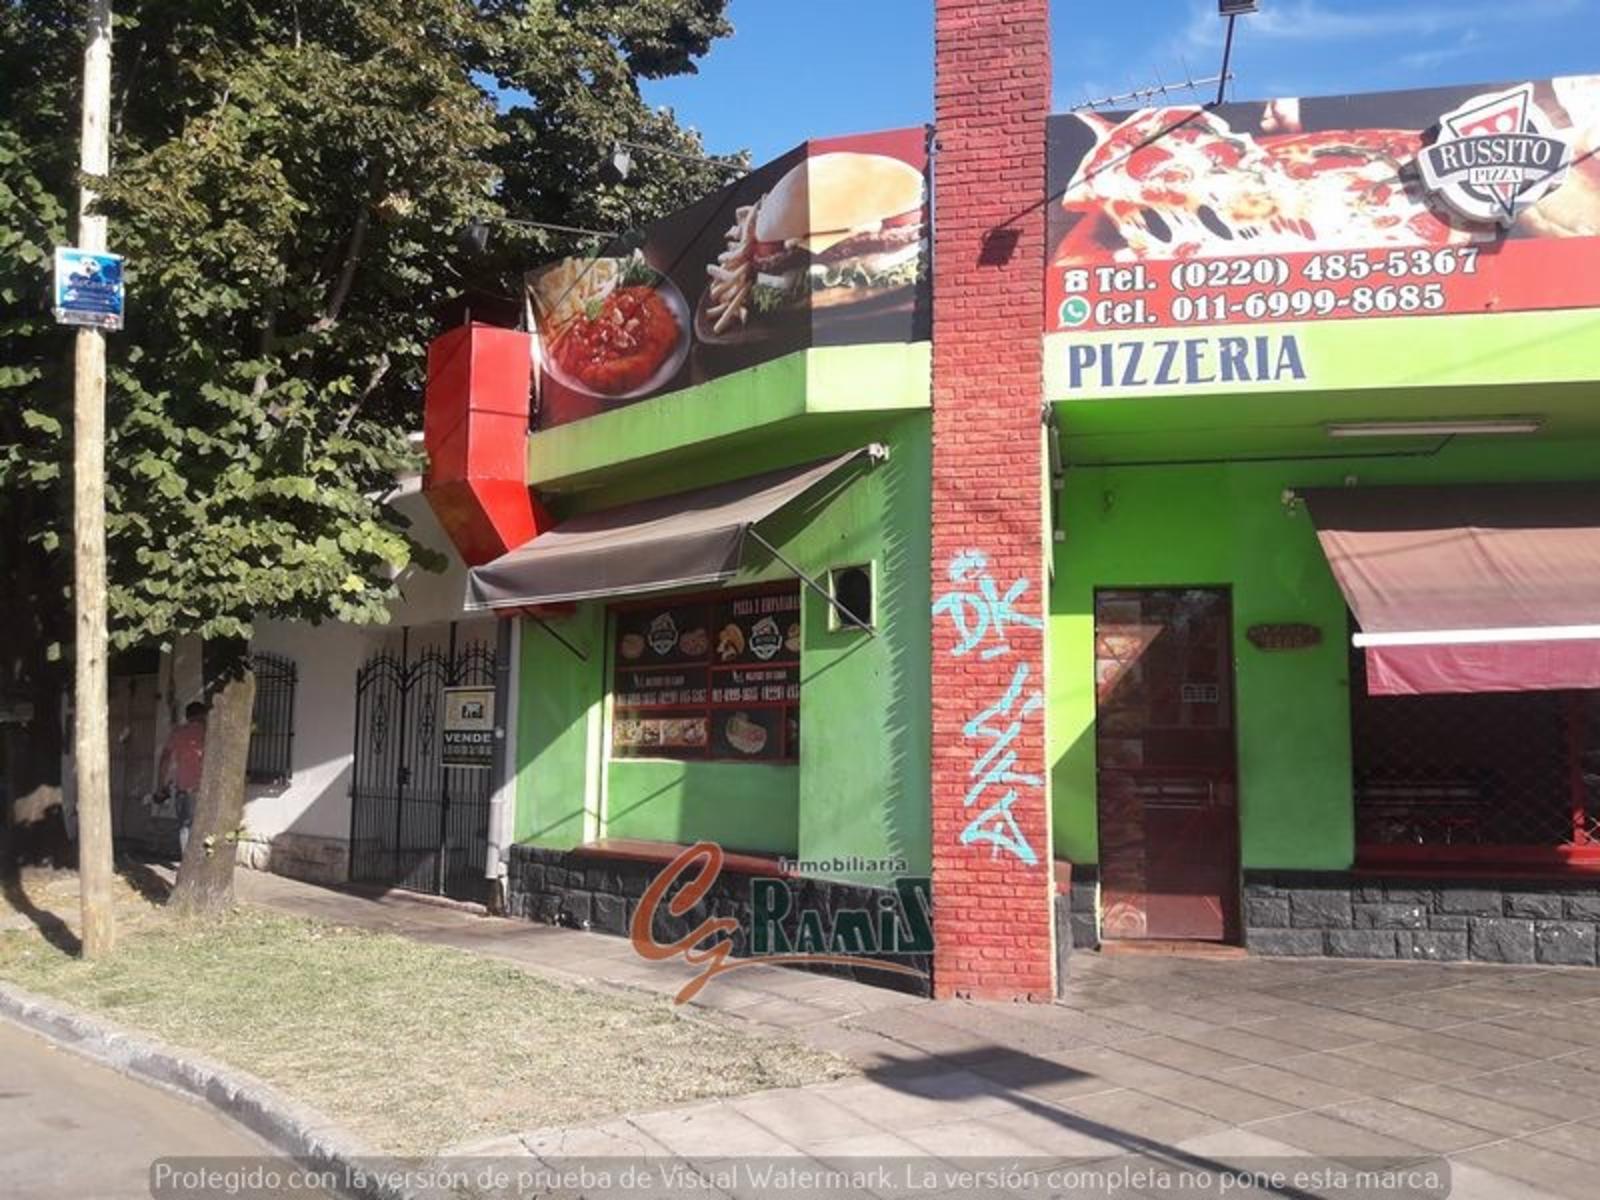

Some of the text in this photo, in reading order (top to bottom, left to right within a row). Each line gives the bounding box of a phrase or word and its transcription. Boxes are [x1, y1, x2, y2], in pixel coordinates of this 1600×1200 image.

[1439, 138, 1551, 171] RUSSITO
[1474, 166, 1520, 182] PIZZA
[1096, 247, 1480, 294] Tel. (0220) 485-5367
[1095, 283, 1444, 325] Cel. 011-6999-8685
[1067, 334, 1307, 389] PIZZERIA
[444, 733, 492, 744] VENDE
